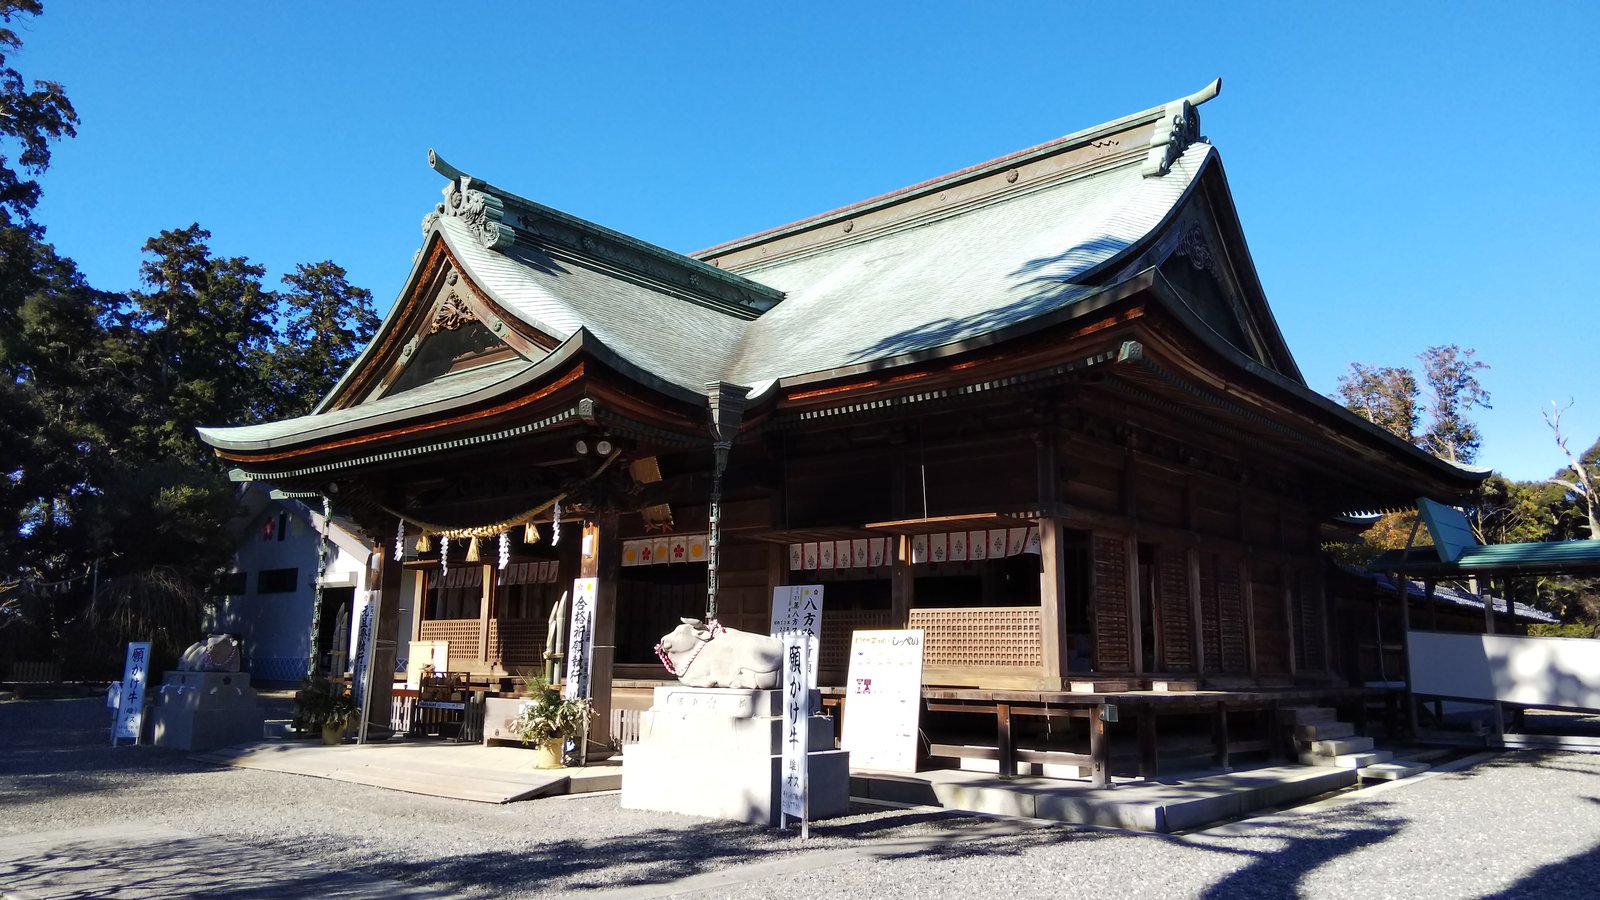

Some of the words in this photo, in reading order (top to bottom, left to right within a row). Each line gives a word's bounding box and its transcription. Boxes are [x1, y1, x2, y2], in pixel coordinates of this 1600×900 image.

[128, 648, 145, 704] 願かけ牛
[789, 645, 801, 751] 願かけ牛
